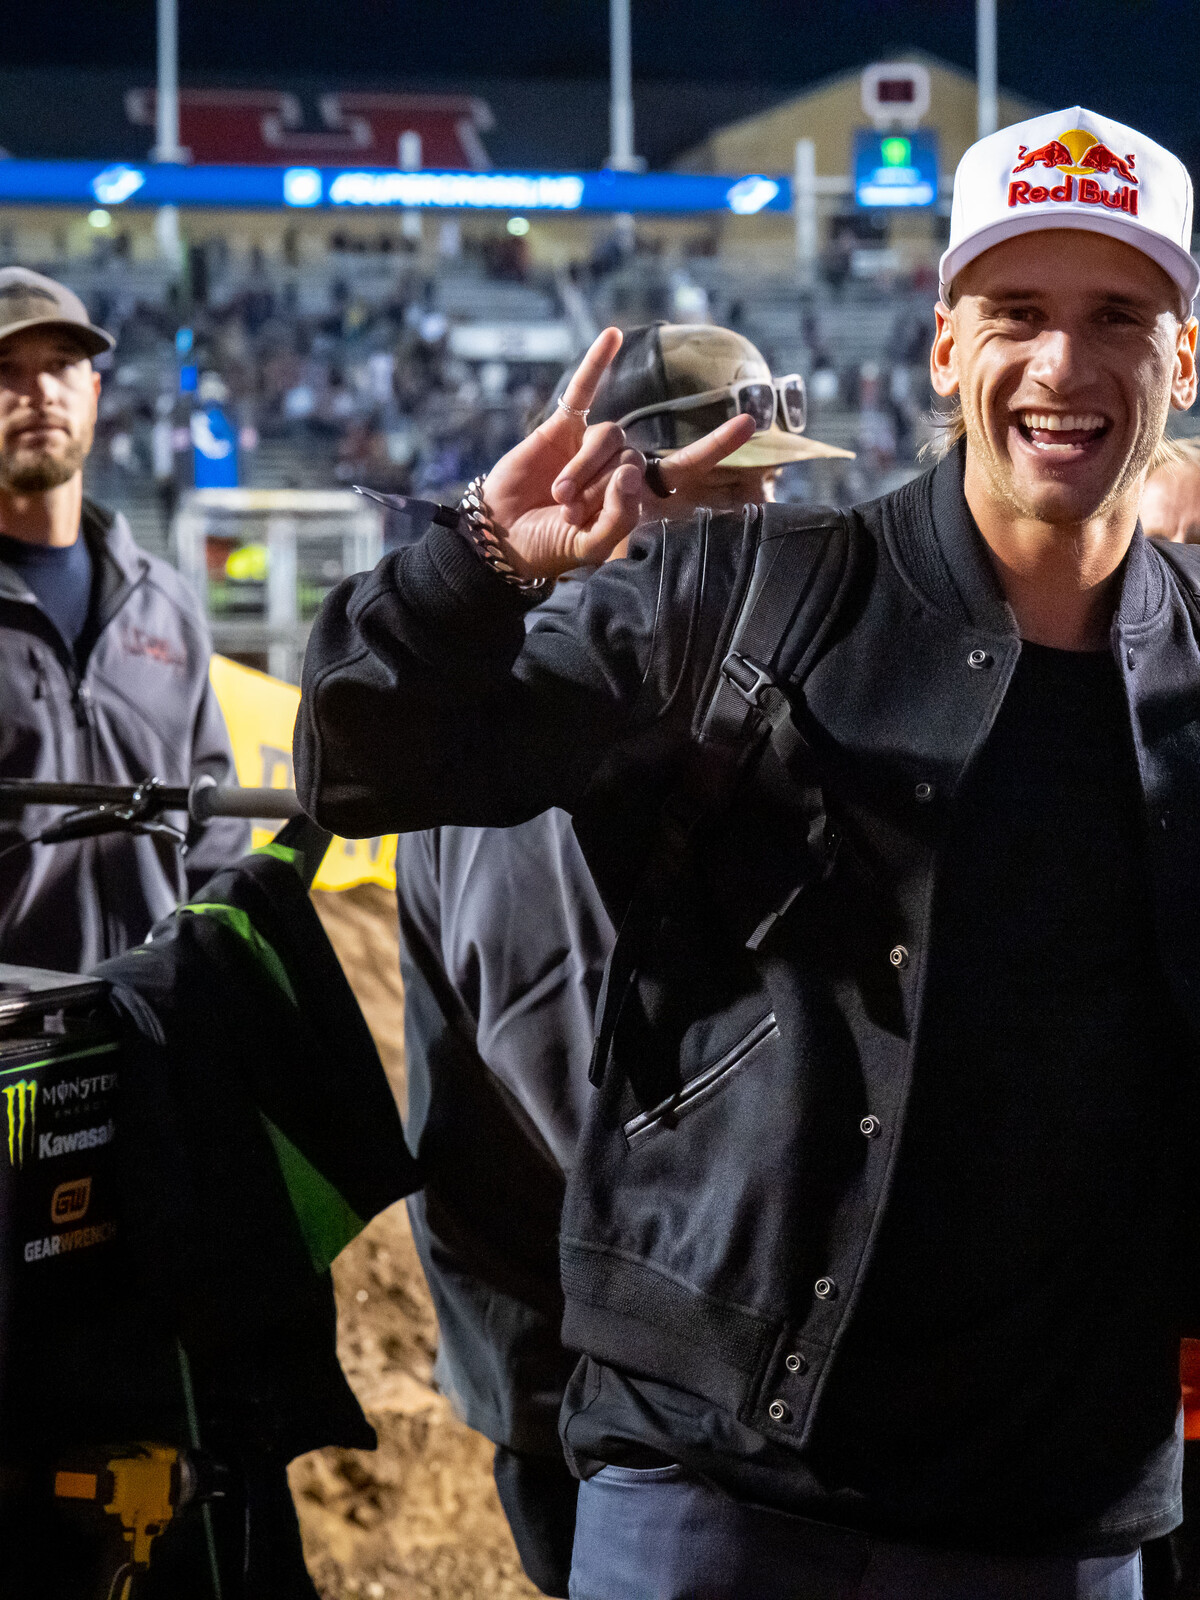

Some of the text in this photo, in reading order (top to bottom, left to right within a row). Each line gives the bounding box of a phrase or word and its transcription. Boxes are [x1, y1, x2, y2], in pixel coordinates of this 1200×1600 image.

[1008, 175, 1138, 216] Red Bull
[39, 1119, 115, 1159] Kawasa
